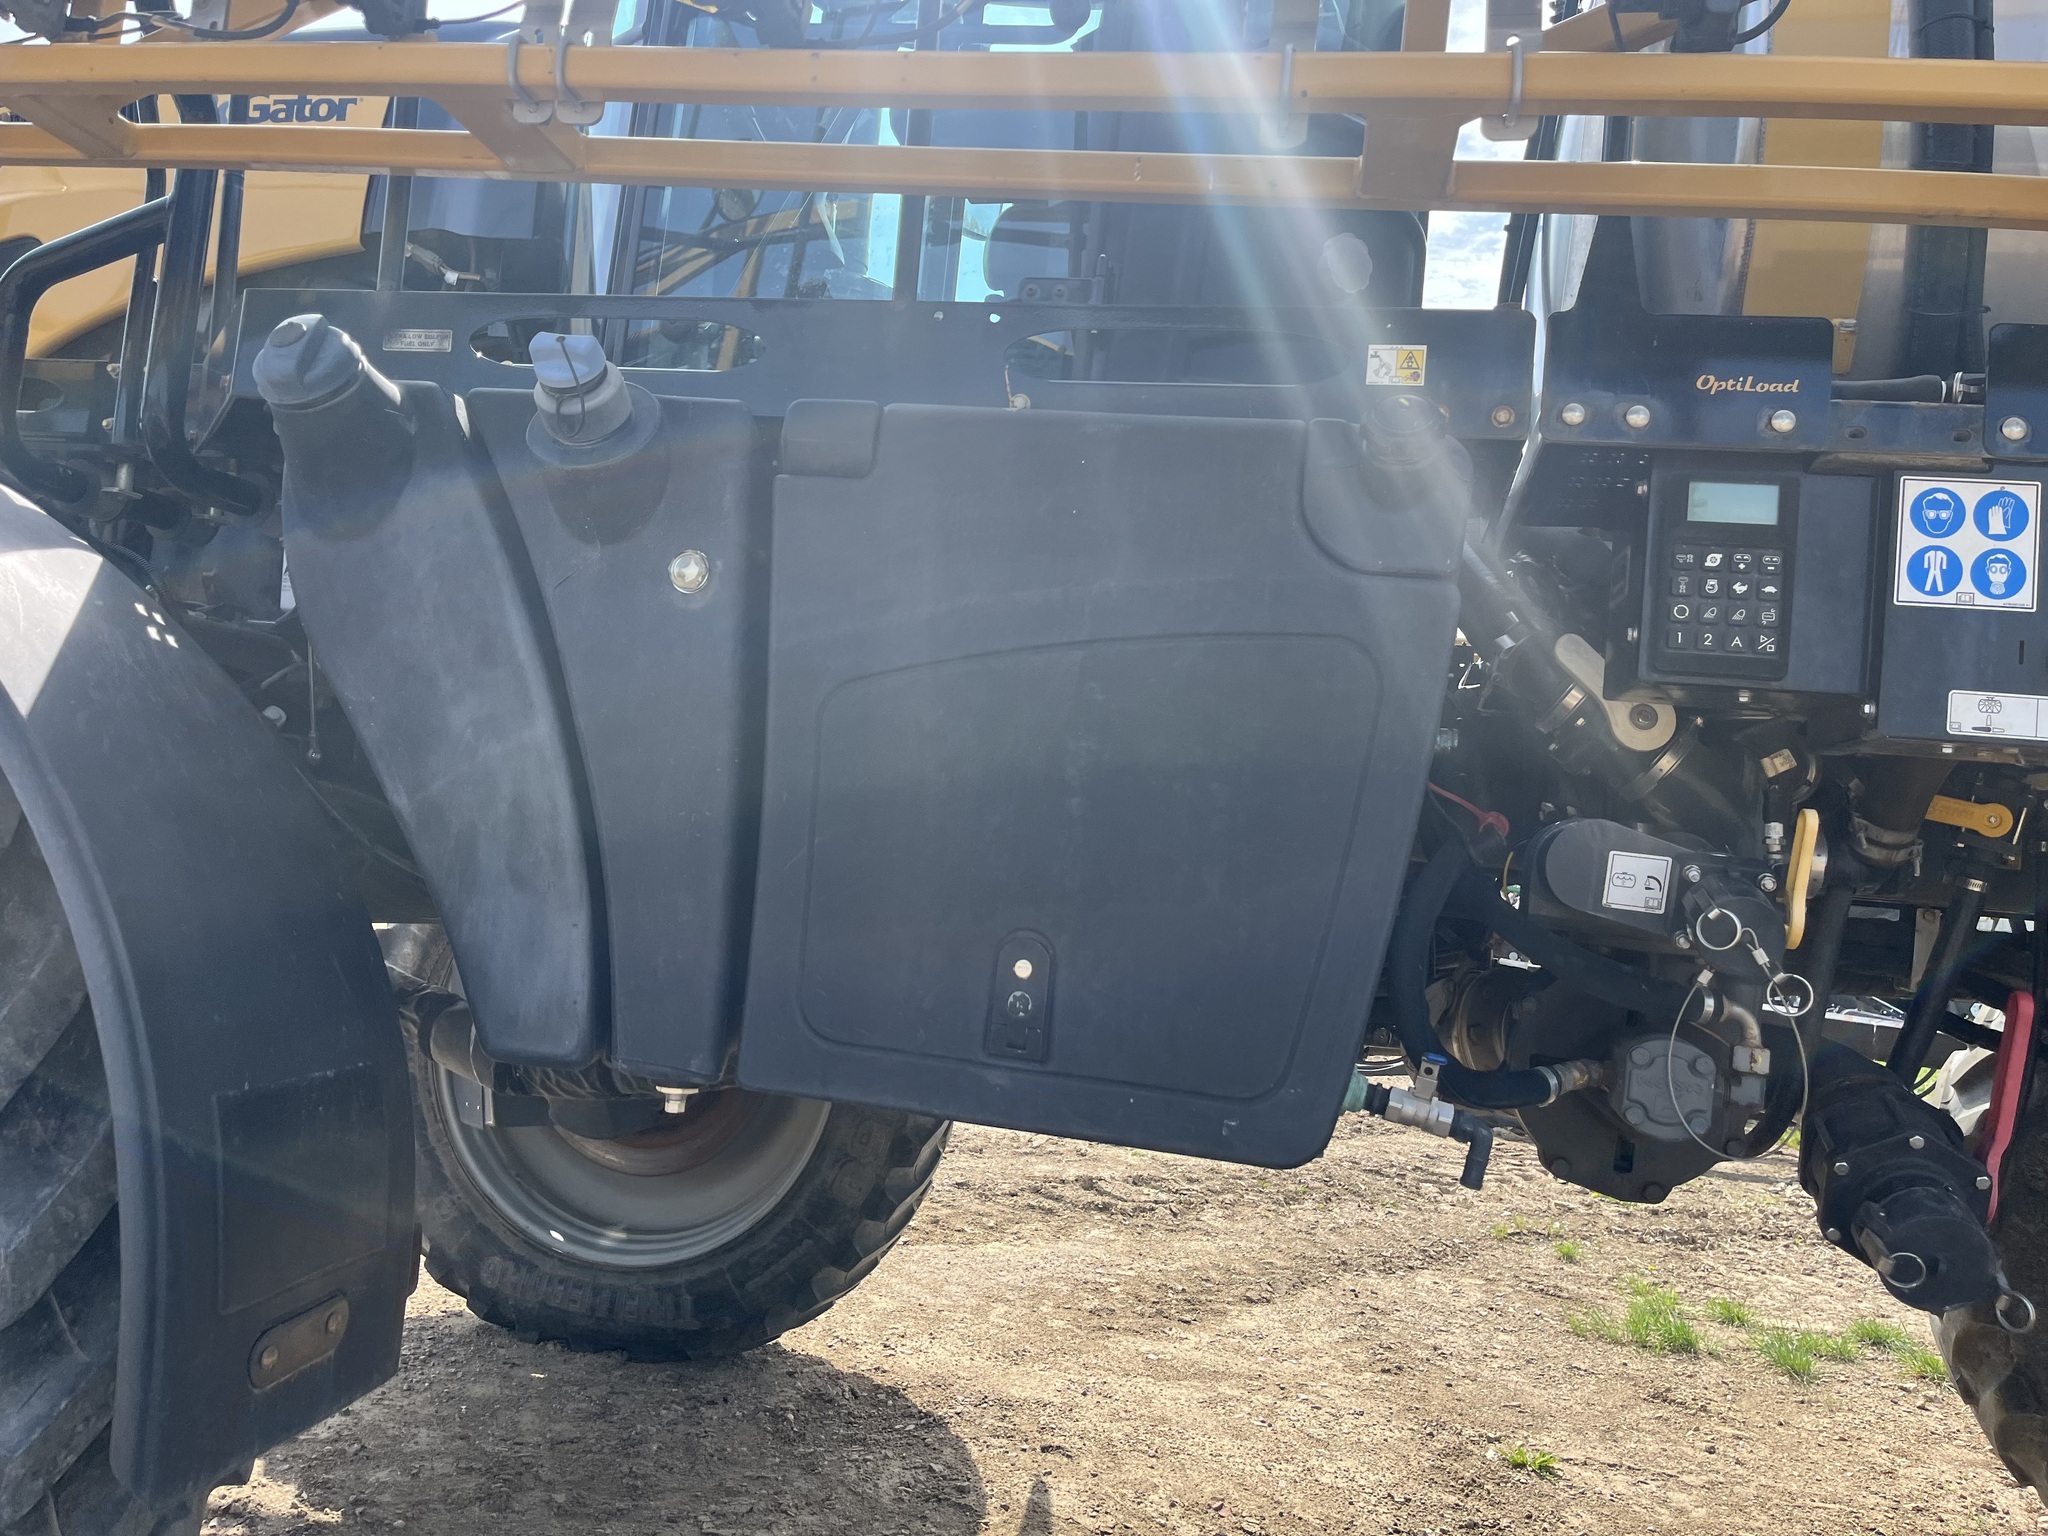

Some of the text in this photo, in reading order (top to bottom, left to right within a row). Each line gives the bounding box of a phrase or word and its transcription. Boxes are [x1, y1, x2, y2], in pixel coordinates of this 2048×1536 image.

[1695, 374, 1800, 395] OptiLoad
[1677, 631, 1743, 648] 1 2 A
